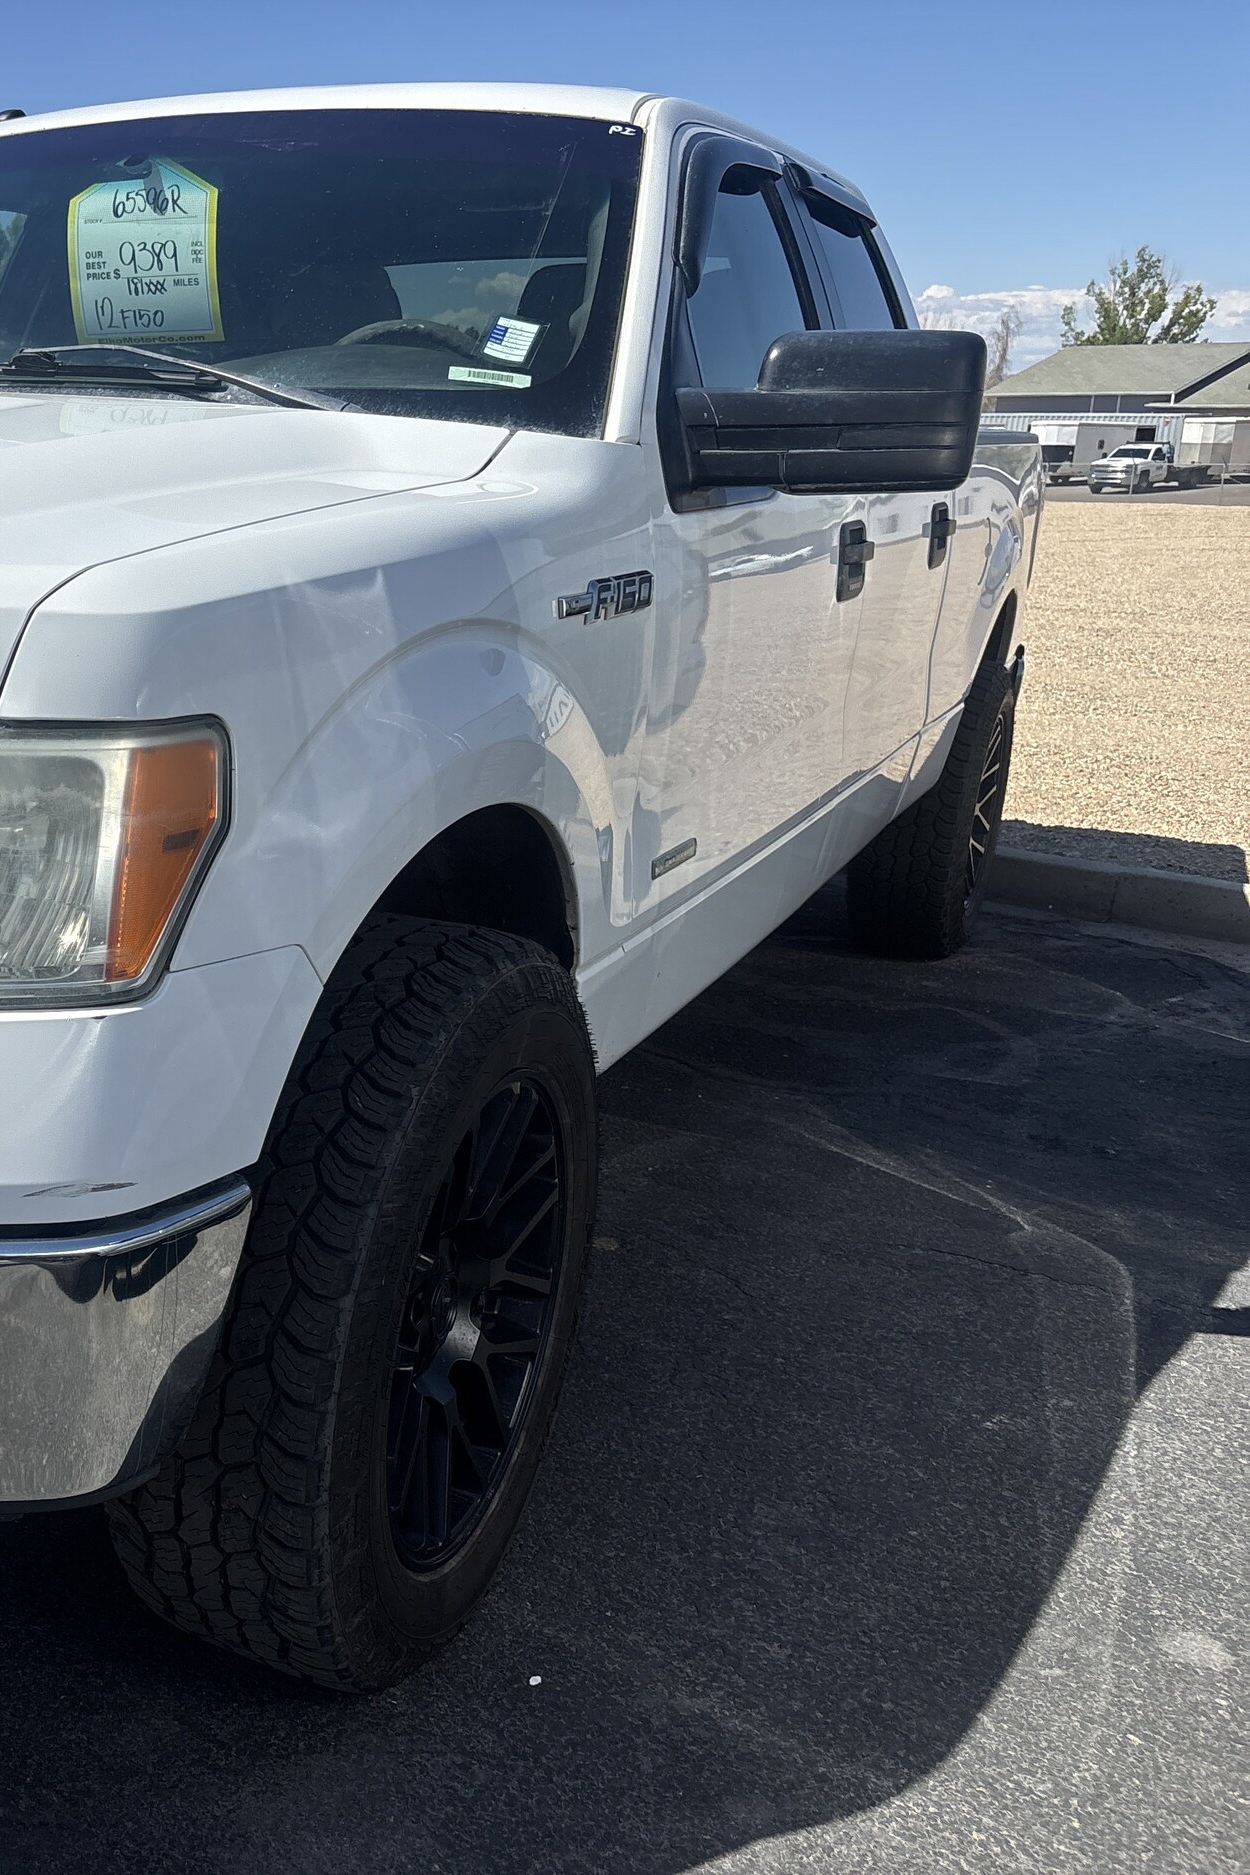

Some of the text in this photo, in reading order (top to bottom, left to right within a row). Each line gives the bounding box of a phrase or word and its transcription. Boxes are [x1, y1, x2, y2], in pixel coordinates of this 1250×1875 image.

[85, 251, 103, 259] OUR
[86, 240, 178, 281] PRICE $ 9389
[85, 261, 106, 270] BEST
[173, 278, 200, 286] MILES
[98, 335, 205, 345] ElkoMotorCo.com
